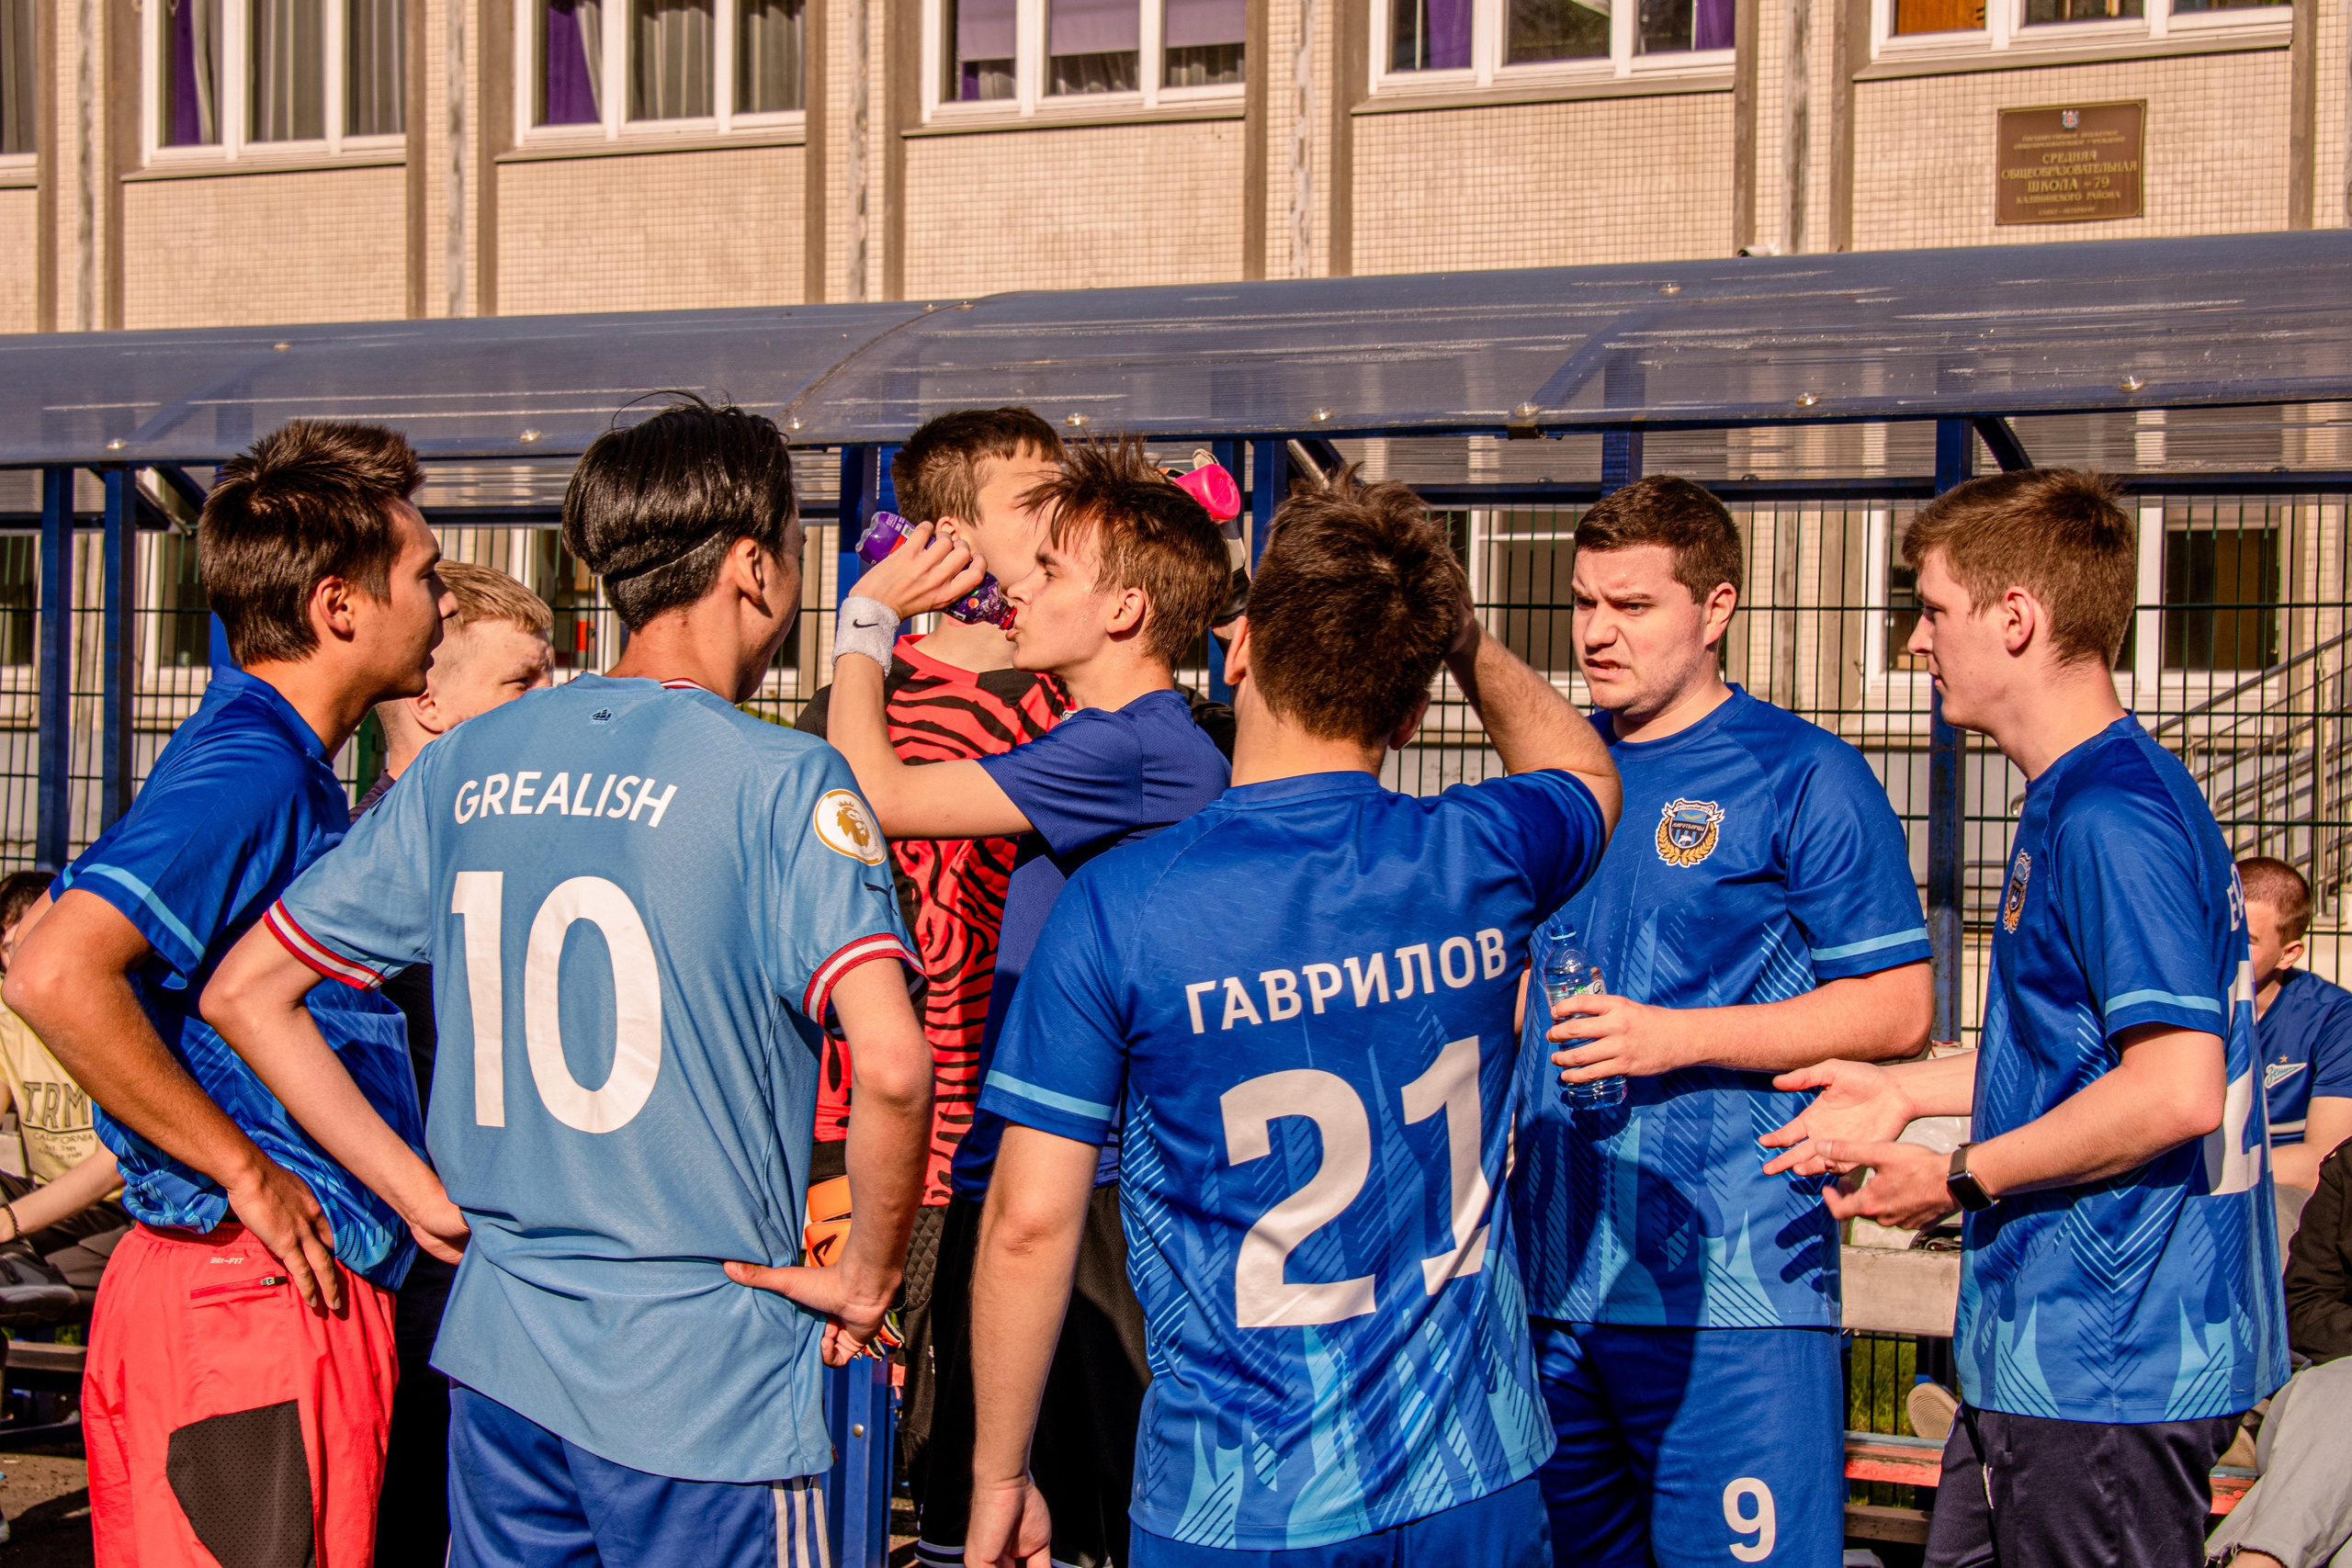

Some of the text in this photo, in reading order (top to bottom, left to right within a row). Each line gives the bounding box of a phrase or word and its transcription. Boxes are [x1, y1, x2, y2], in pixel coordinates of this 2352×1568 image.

[2001, 161, 2137, 180] ОБЩЕОБРАЗОВАТЕЛЬНАЯ
[2027, 178, 2078, 193] ШКОЛА
[2094, 175, 2110, 189] 79
[2041, 150, 2097, 164] СРЕДНЯЯ
[454, 771, 678, 828] GREALISH
[451, 871, 662, 1134] 10
[1184, 927, 1507, 1035] ГАВРИЛОВ
[34, 1132, 94, 1145] CALIFORNIA
[1219, 1035, 1491, 1328] 21
[1723, 1477, 1775, 1562] 9
